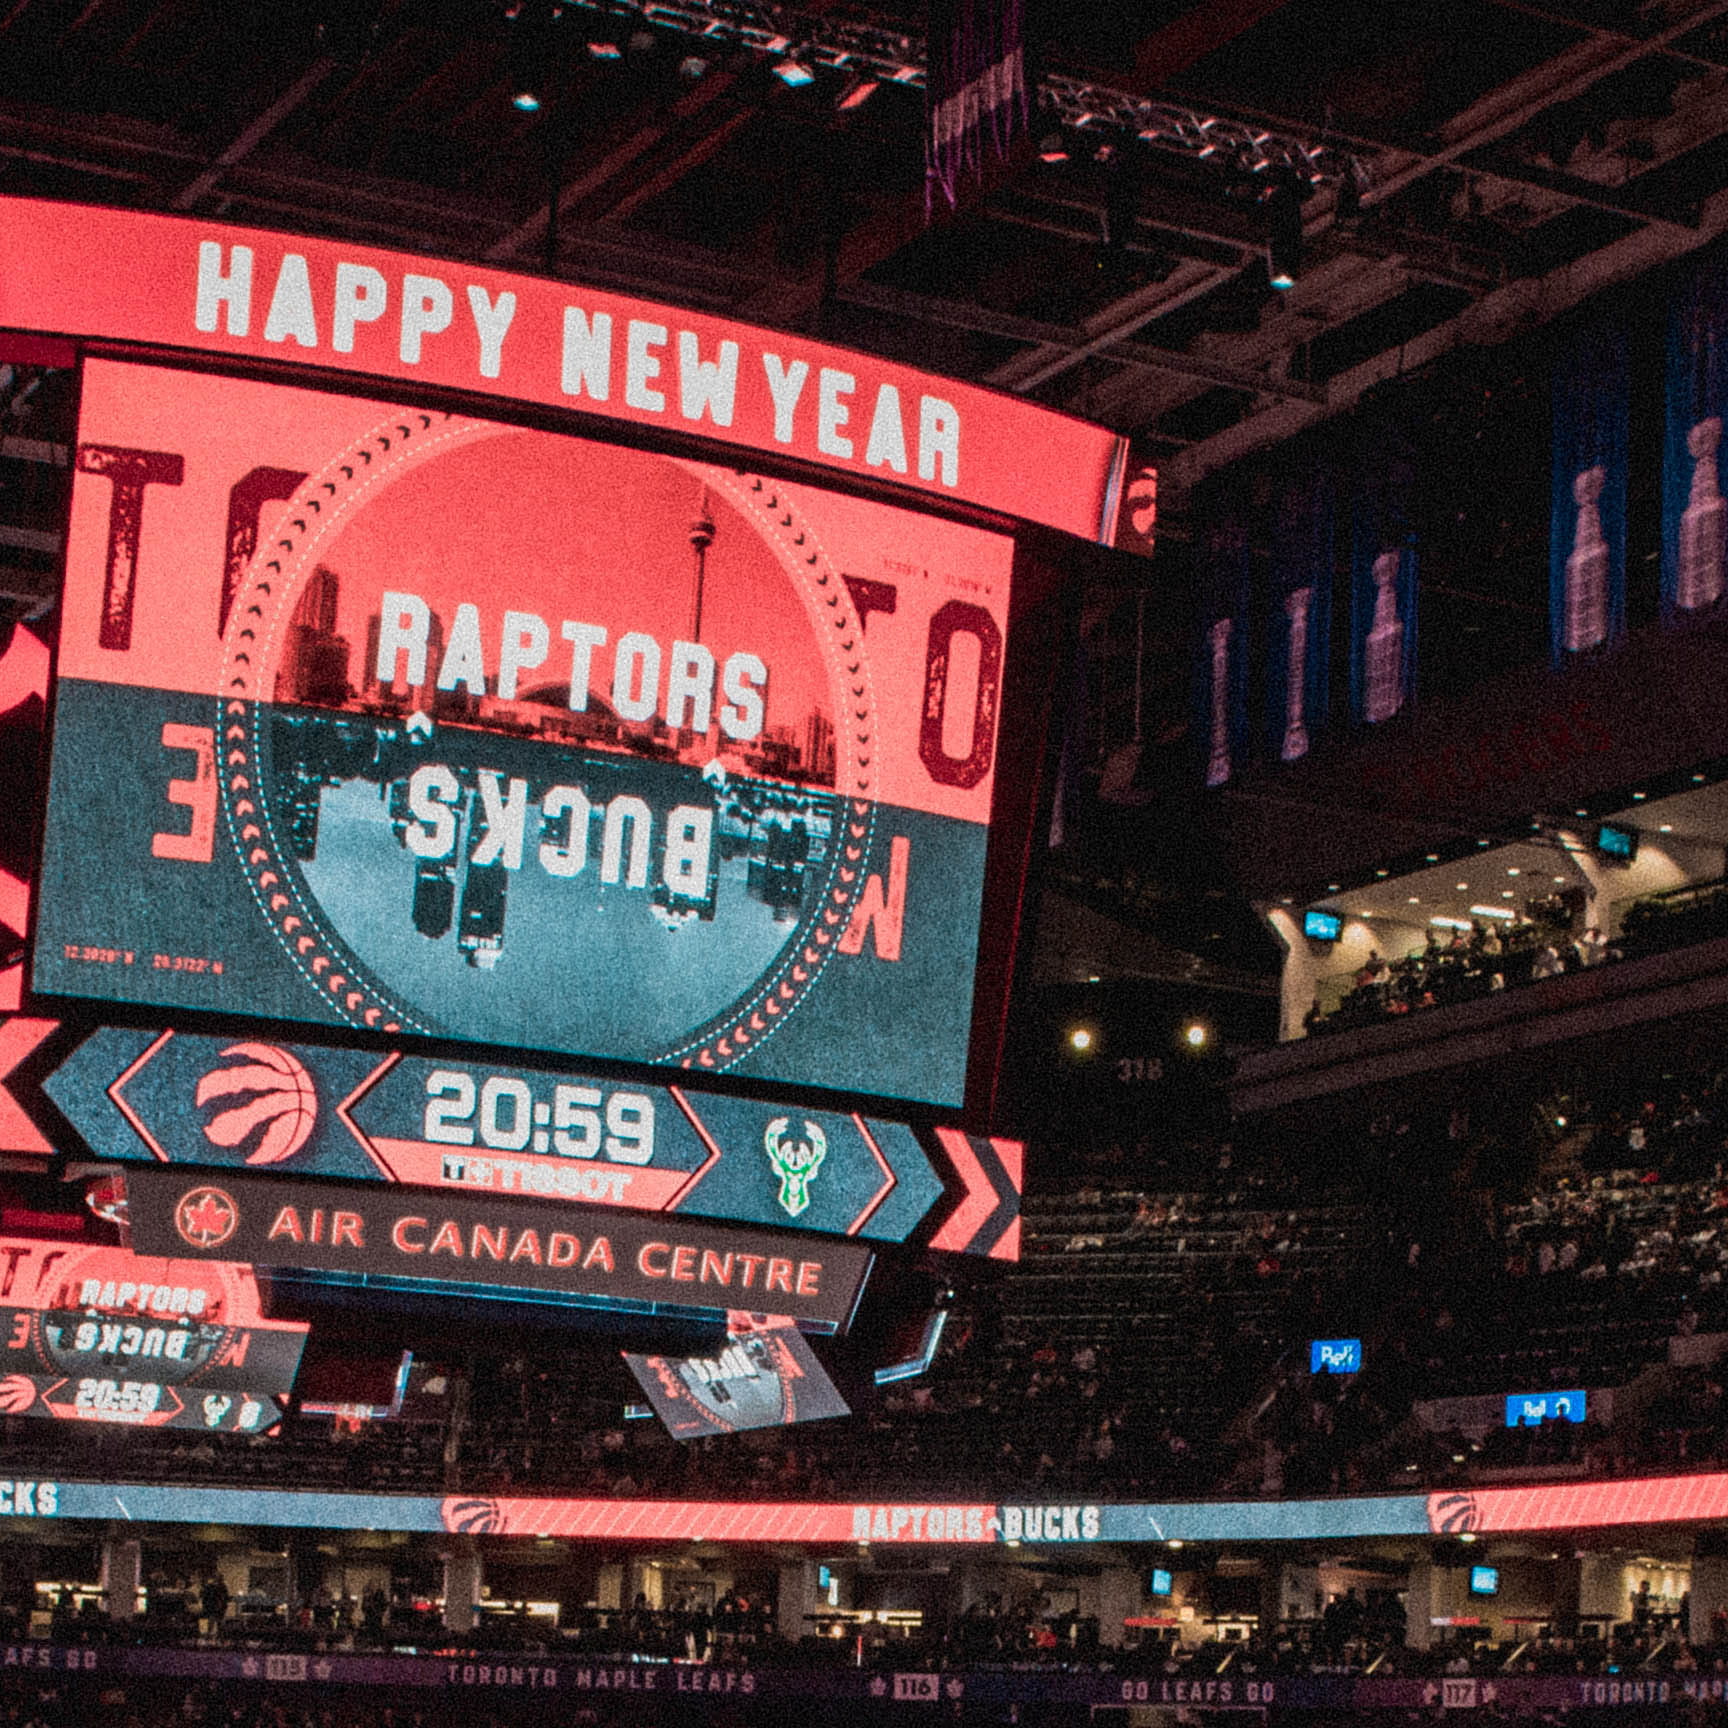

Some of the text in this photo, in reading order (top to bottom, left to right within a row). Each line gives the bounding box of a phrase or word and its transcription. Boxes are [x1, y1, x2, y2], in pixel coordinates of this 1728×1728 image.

[194, 240, 961, 488] HAPPY NEW YEAR
[375, 590, 768, 741] RAPTORS
[405, 764, 719, 900] BUCKS
[422, 1069, 656, 1167] 20:59
[497, 1157, 634, 1206] TISSOT
[269, 1203, 823, 1297] AIR CANADA CENTRE
[79, 1276, 208, 1317] RAPTORS
[71, 1309, 189, 1362] BUCKS
[73, 1376, 162, 1415] 20:59
[853, 1504, 1101, 1543] RAPTORS BUCKS
[447, 1662, 757, 1695] TORONTO MAPLE LEAFS
[900, 1677, 932, 1696] 116
[1161, 1679, 1234, 1702] LEAFS
